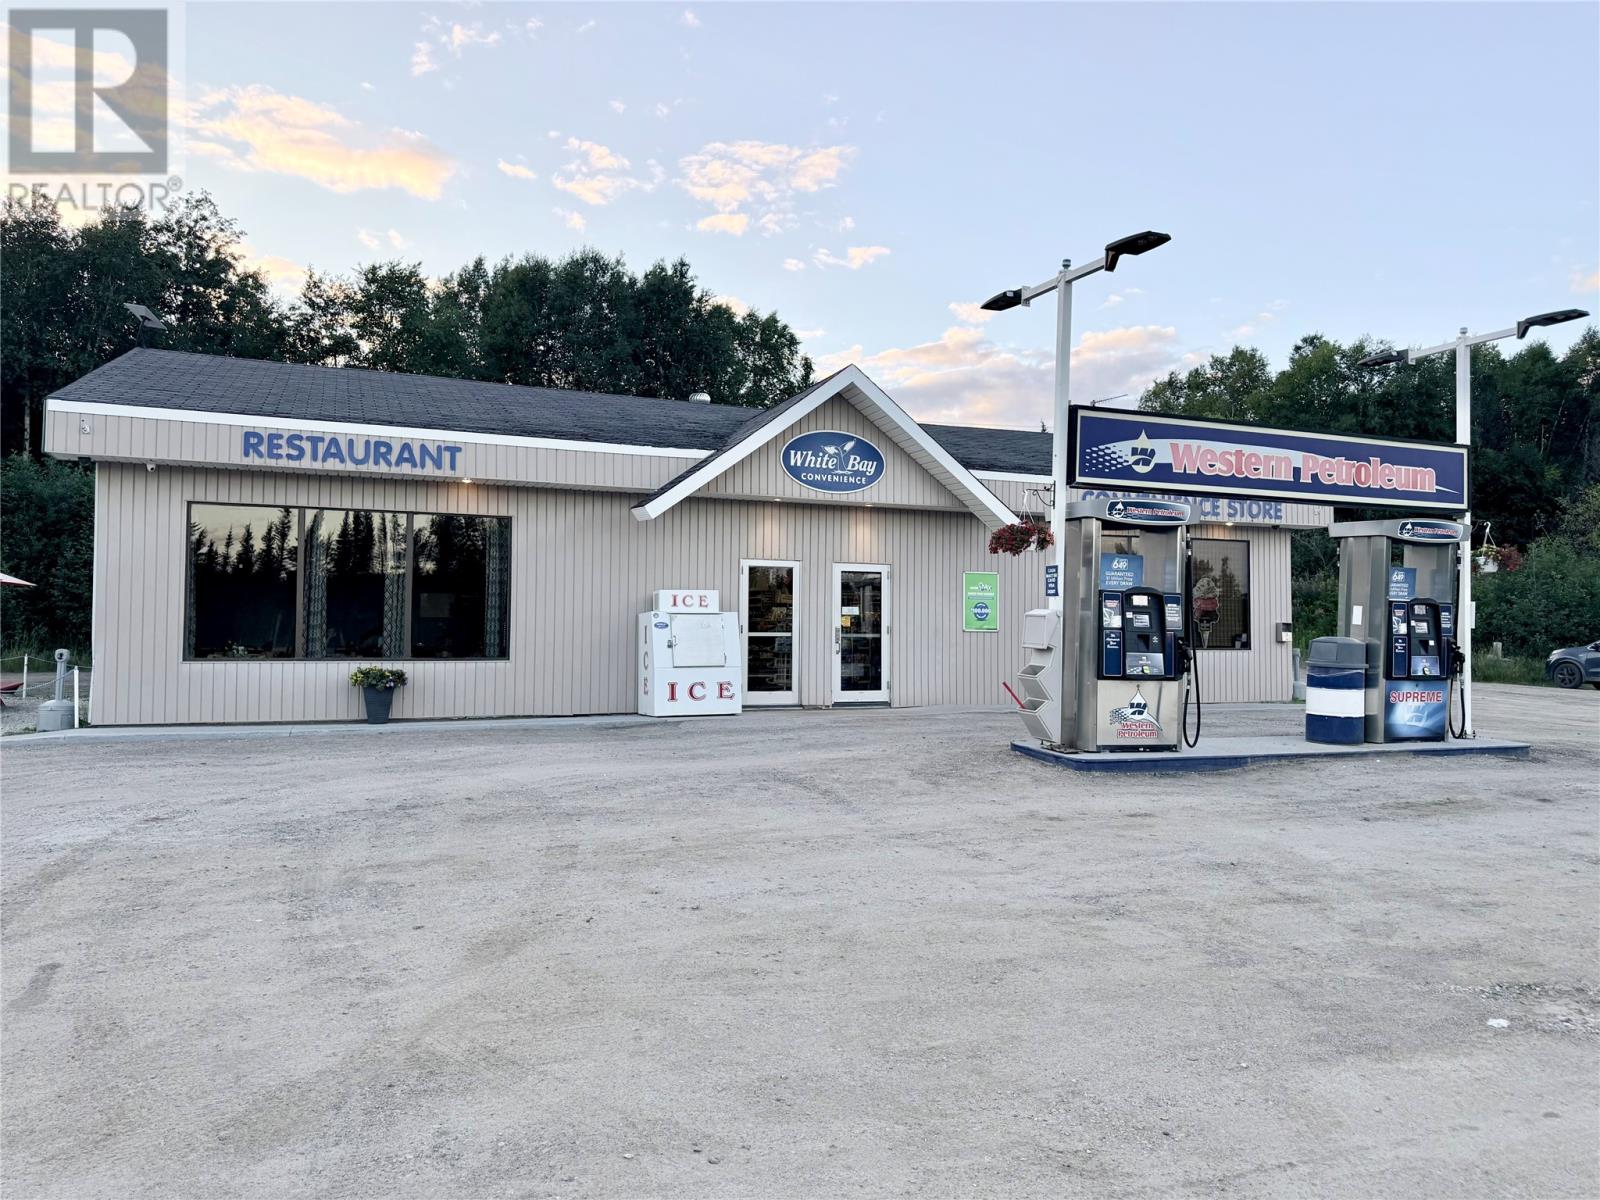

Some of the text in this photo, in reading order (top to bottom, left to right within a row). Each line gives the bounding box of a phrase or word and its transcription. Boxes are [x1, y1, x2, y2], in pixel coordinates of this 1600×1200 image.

[243, 431, 463, 471] RESTAURANT
[789, 450, 878, 476] White Bay
[1169, 442, 1436, 493] Western Petroleum
[801, 473, 867, 485] CONVENIENCE
[1227, 499, 1283, 520] STORE
[671, 594, 709, 608] ICE
[667, 681, 736, 702] ICE
[1390, 690, 1443, 704] SUPREME
[1120, 721, 1153, 729] Western
[1117, 730, 1158, 738] Petroleum
